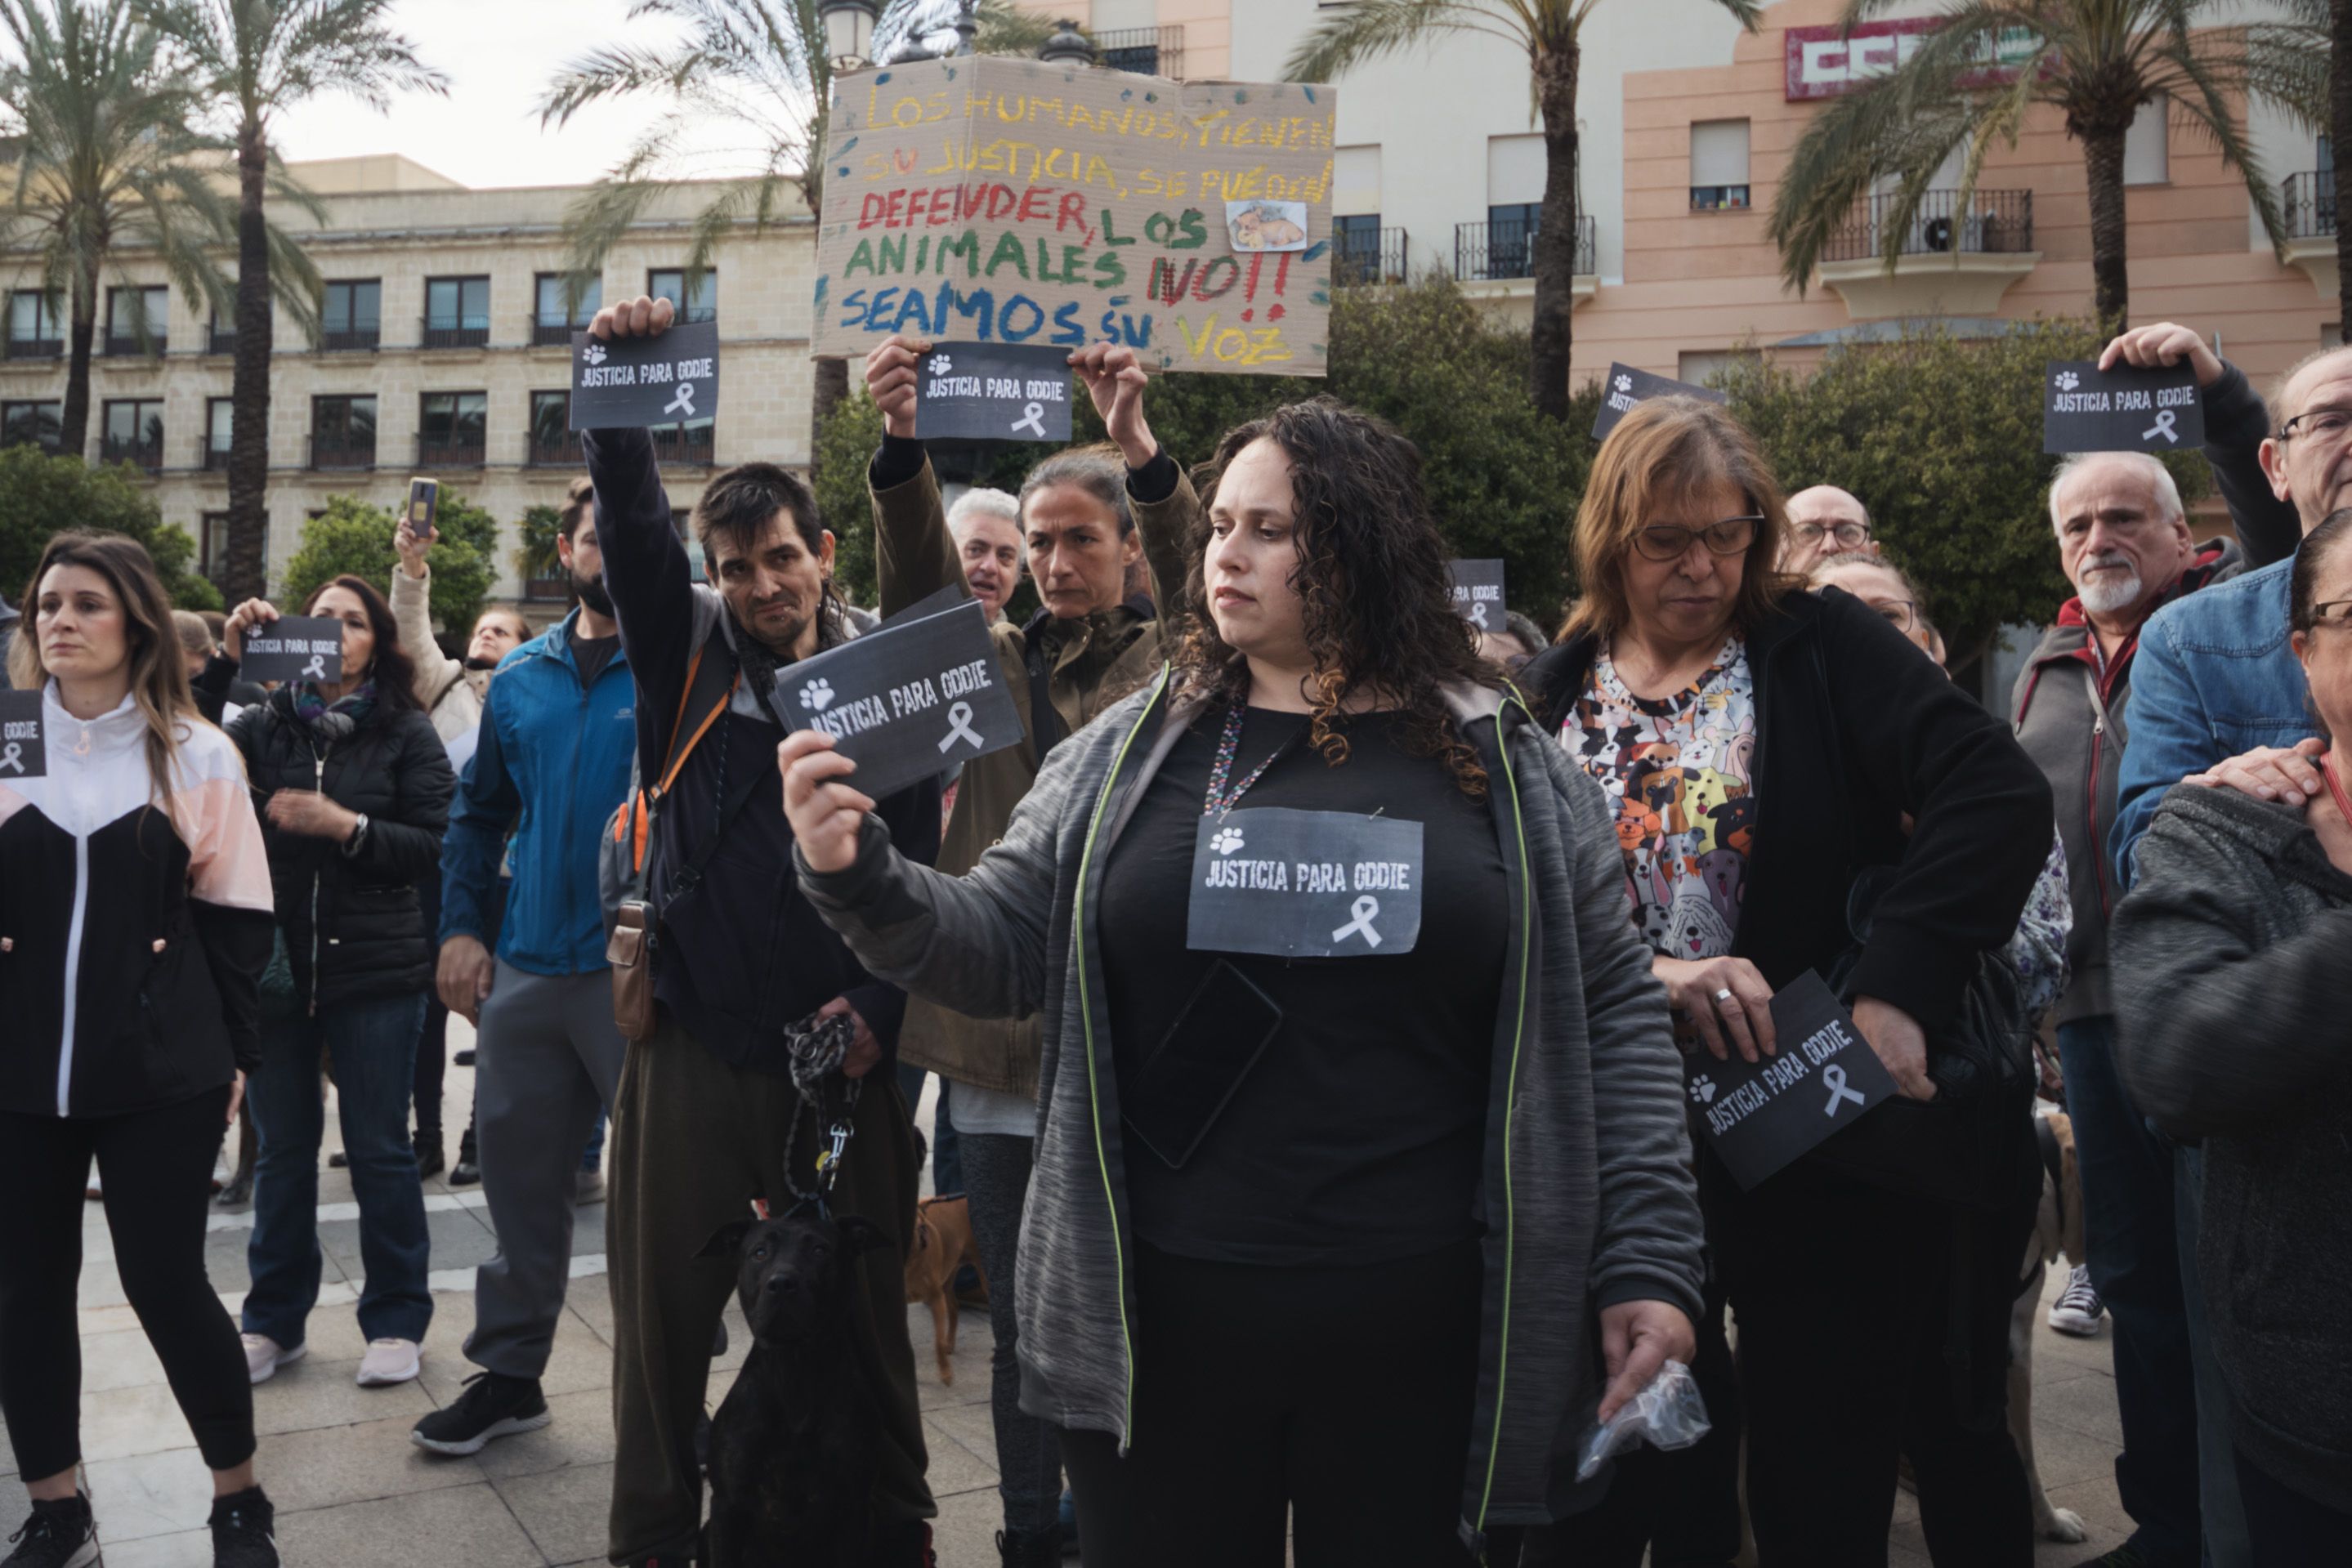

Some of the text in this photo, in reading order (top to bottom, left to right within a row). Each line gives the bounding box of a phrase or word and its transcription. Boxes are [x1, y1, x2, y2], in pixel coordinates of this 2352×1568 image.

[867, 85, 1335, 150] LOS HUMANOS, TIENEN
[863, 137, 1335, 203] SU JUSTICIA, SE PUEDEN
[857, 183, 1208, 248] DEFENDER, LOS
[844, 229, 1291, 323] ANIMALES NO!!
[840, 280, 1086, 346] SEAMOS
[1176, 311, 1294, 366] VOZ
[581, 357, 713, 387] JUSTICIA PARA ODDIE
[926, 376, 1065, 401] JUSTICIA PARA ODDIE
[1607, 391, 1638, 412] JUSTI
[2054, 385, 2195, 412] JUSTICIA PARA ODDIE
[1472, 584, 1500, 601] ODDIE
[247, 638, 338, 656] JUSTICIA PARA ODDIE
[889, 677, 939, 718] PARA
[940, 659, 992, 699] ODDIE
[4, 721, 38, 740] ODDIE
[1205, 860, 1410, 892] JUSTICIA PARA ODDIE
[1706, 1018, 1853, 1137] JUSTICIA PARA ODDIE
